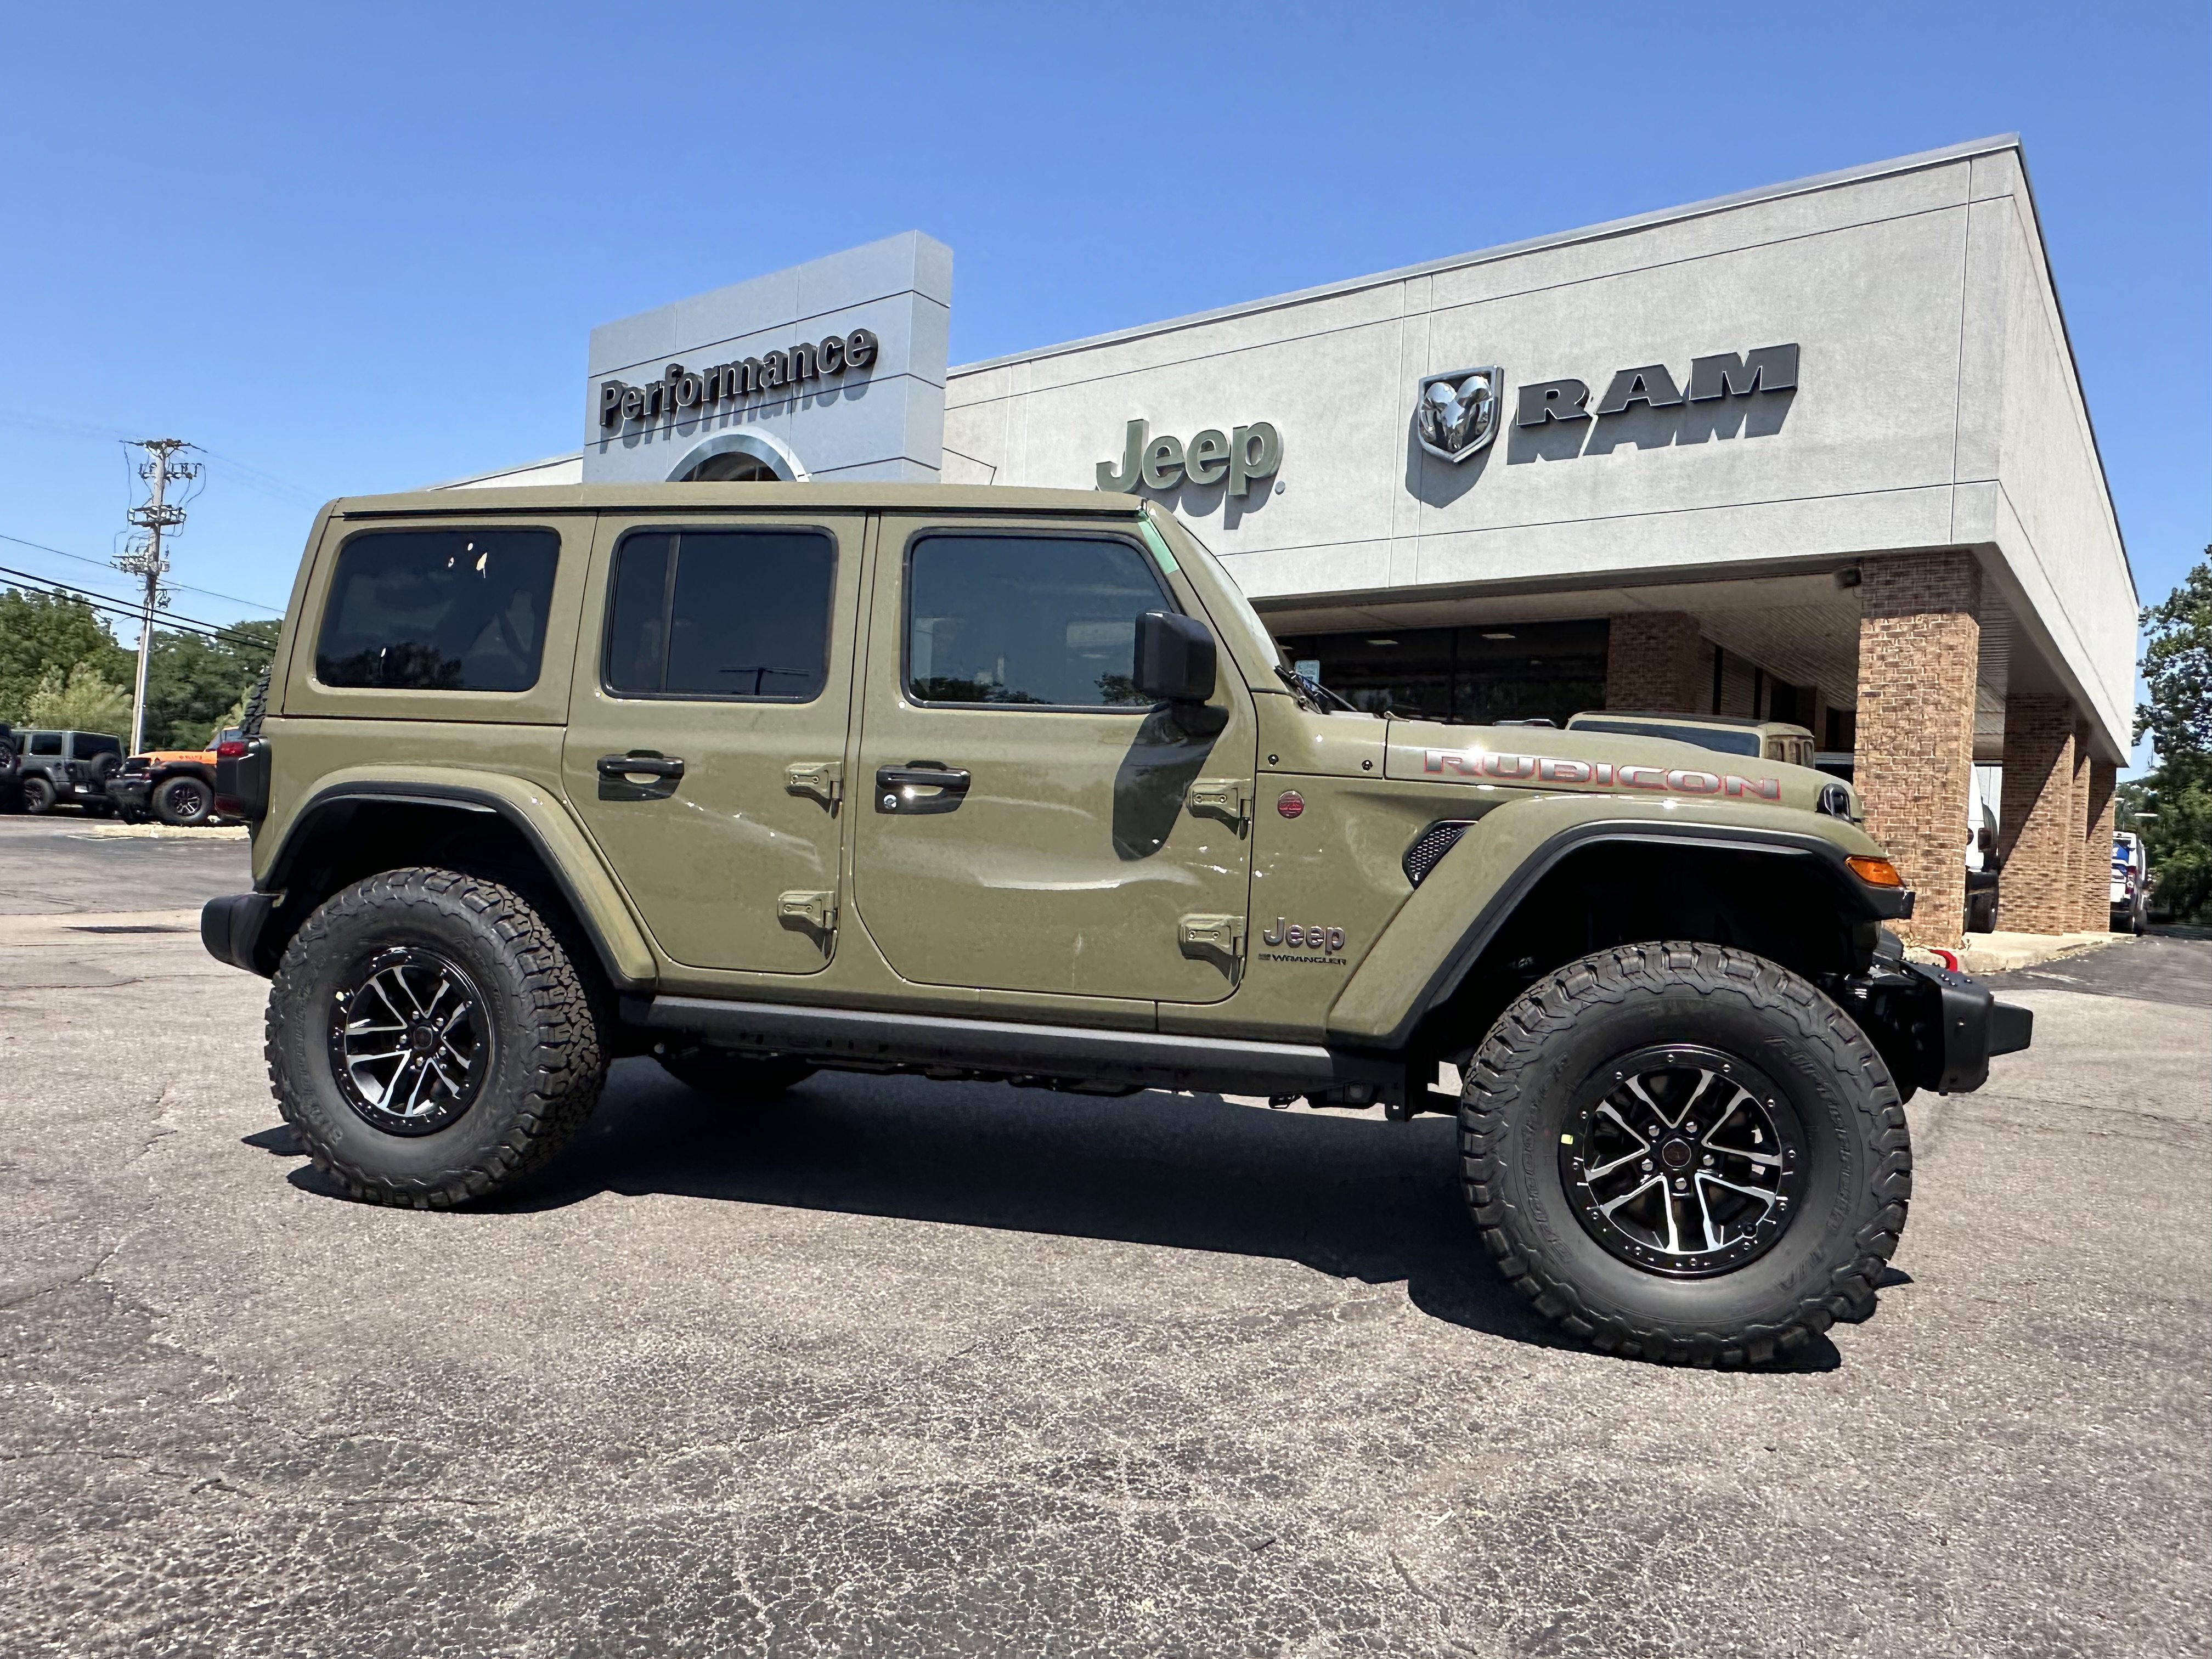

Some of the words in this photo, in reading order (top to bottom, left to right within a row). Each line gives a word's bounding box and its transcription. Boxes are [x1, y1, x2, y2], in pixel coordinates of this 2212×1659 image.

[600, 328, 878, 427] Performance
[1516, 343, 1800, 426] RAM
[1096, 418, 1284, 495] Jeep
[1424, 749, 1781, 800] RUBICON
[1263, 917, 1345, 955] Jeep
[1272, 954, 1346, 965] WRANGLER
